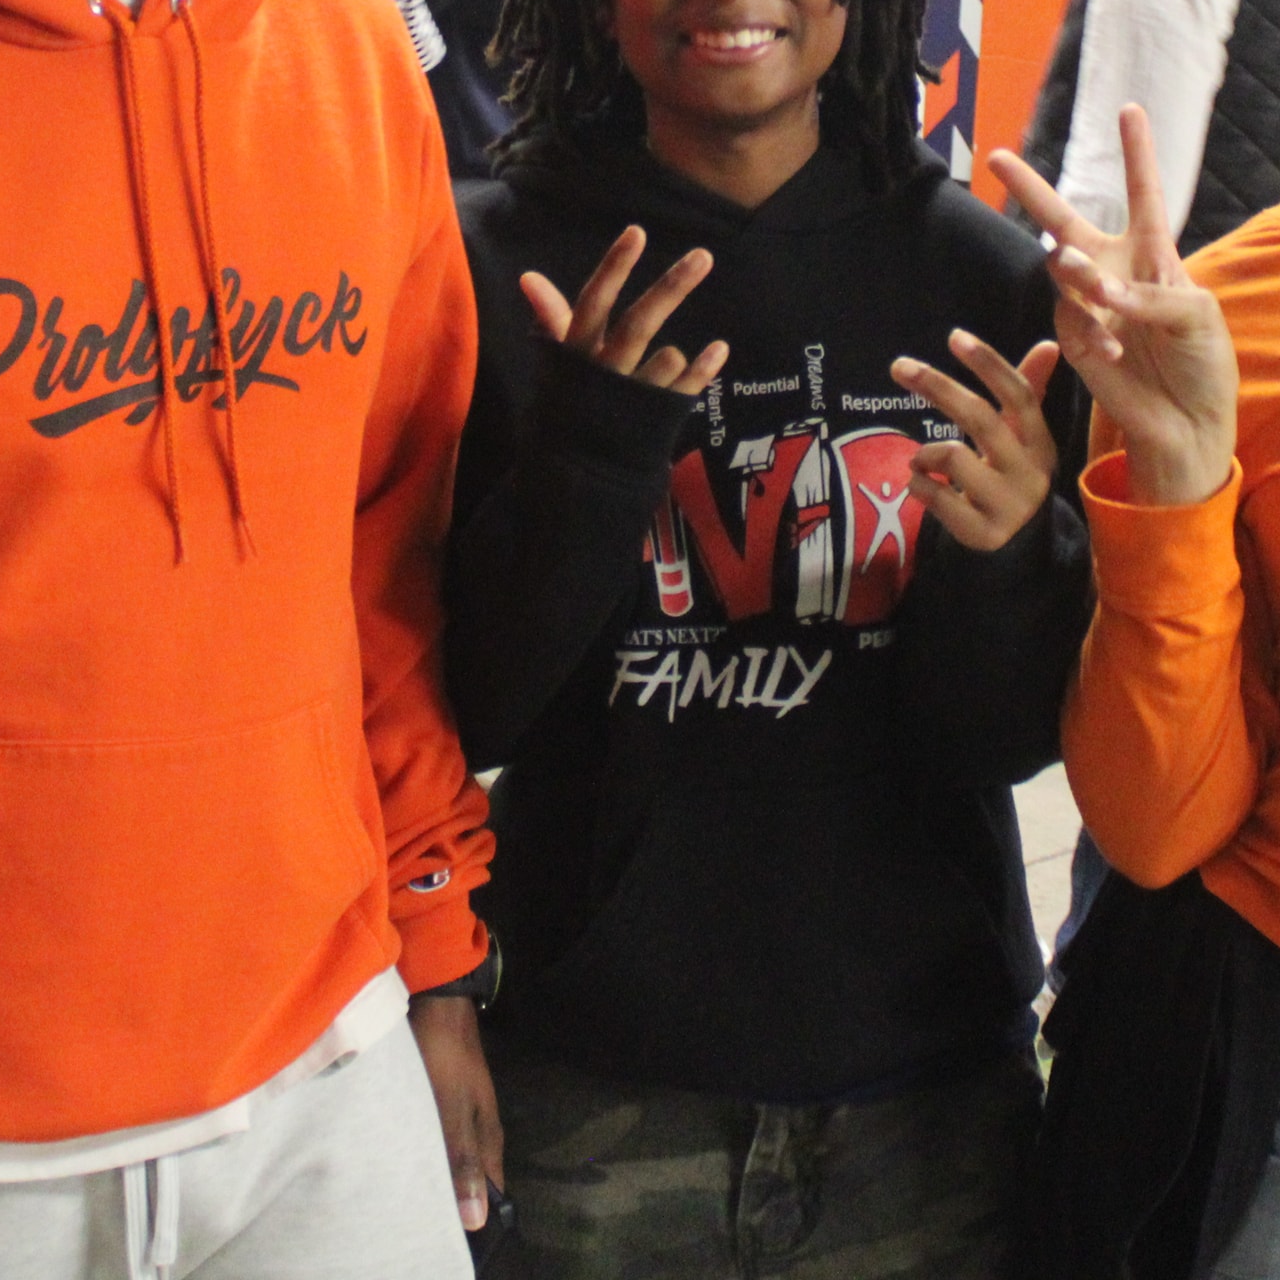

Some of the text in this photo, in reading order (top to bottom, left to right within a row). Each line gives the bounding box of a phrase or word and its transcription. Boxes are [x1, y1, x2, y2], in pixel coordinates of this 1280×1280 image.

[733, 375, 800, 396] Potential
[804, 343, 826, 410] Dreams
[922, 419, 960, 439] Tena
[609, 646, 832, 723] FAMILY
